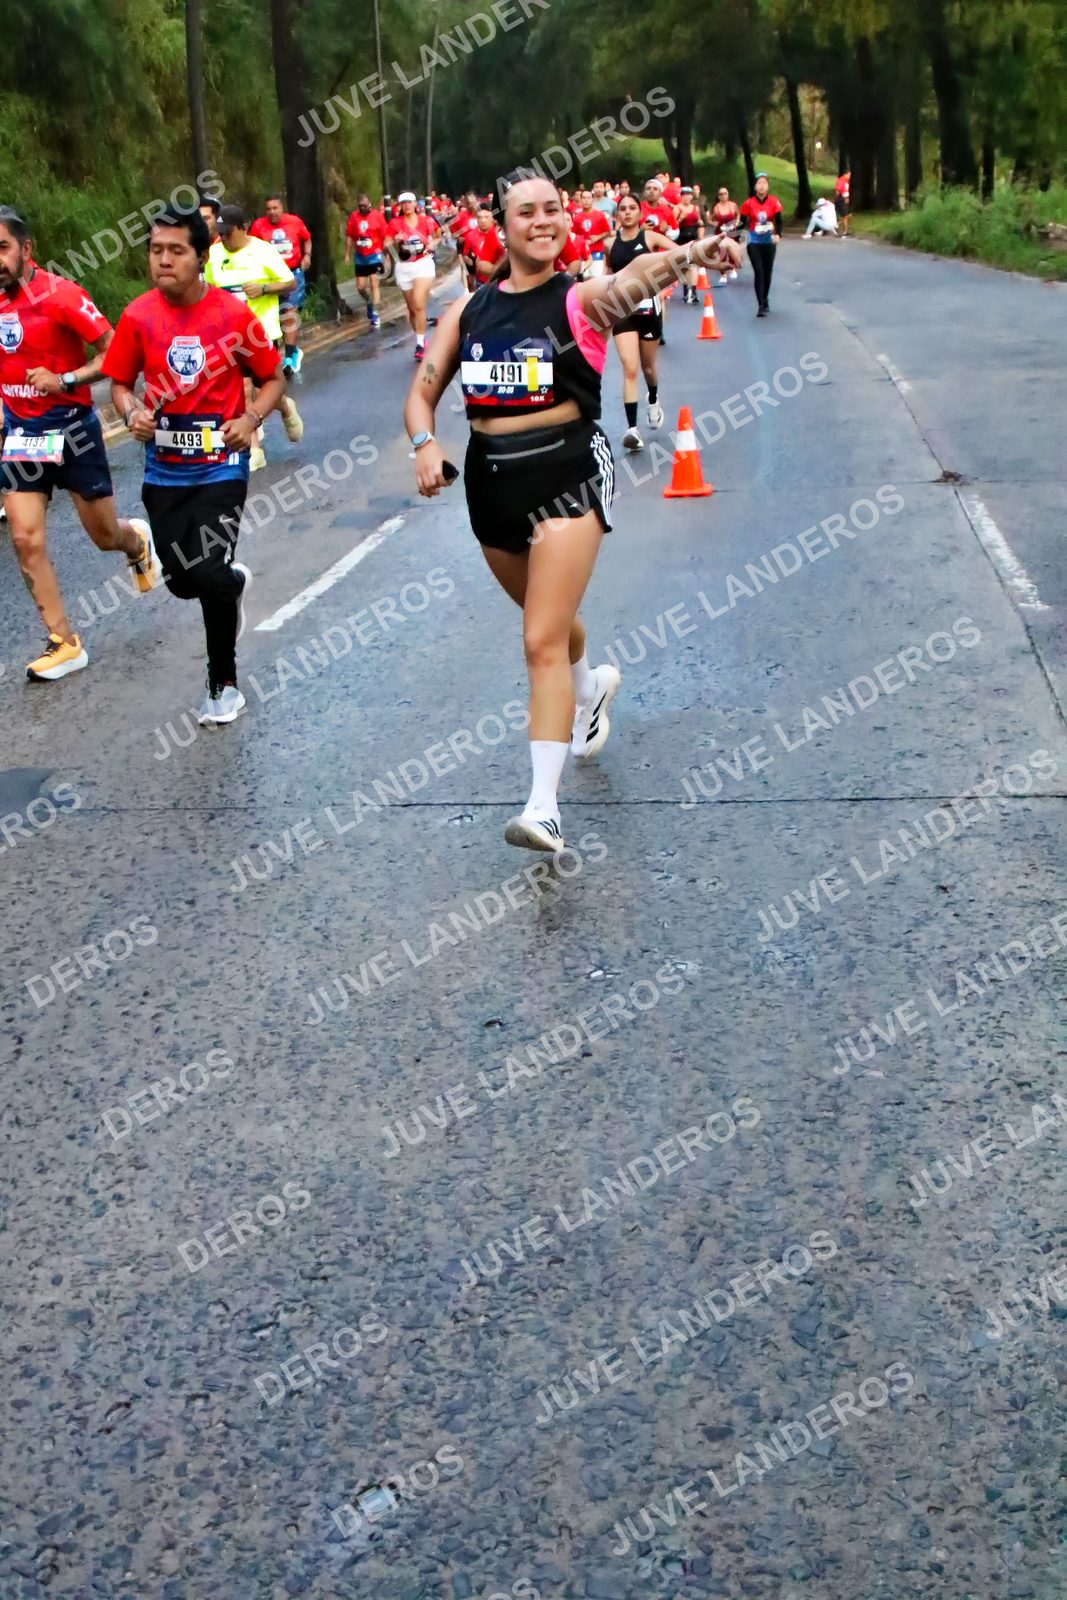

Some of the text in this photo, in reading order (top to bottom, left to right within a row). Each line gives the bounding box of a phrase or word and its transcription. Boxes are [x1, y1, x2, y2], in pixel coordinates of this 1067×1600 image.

[490, 364, 523, 383] 4191
[22, 437, 46, 448] 4132
[172, 432, 203, 447] 4493
